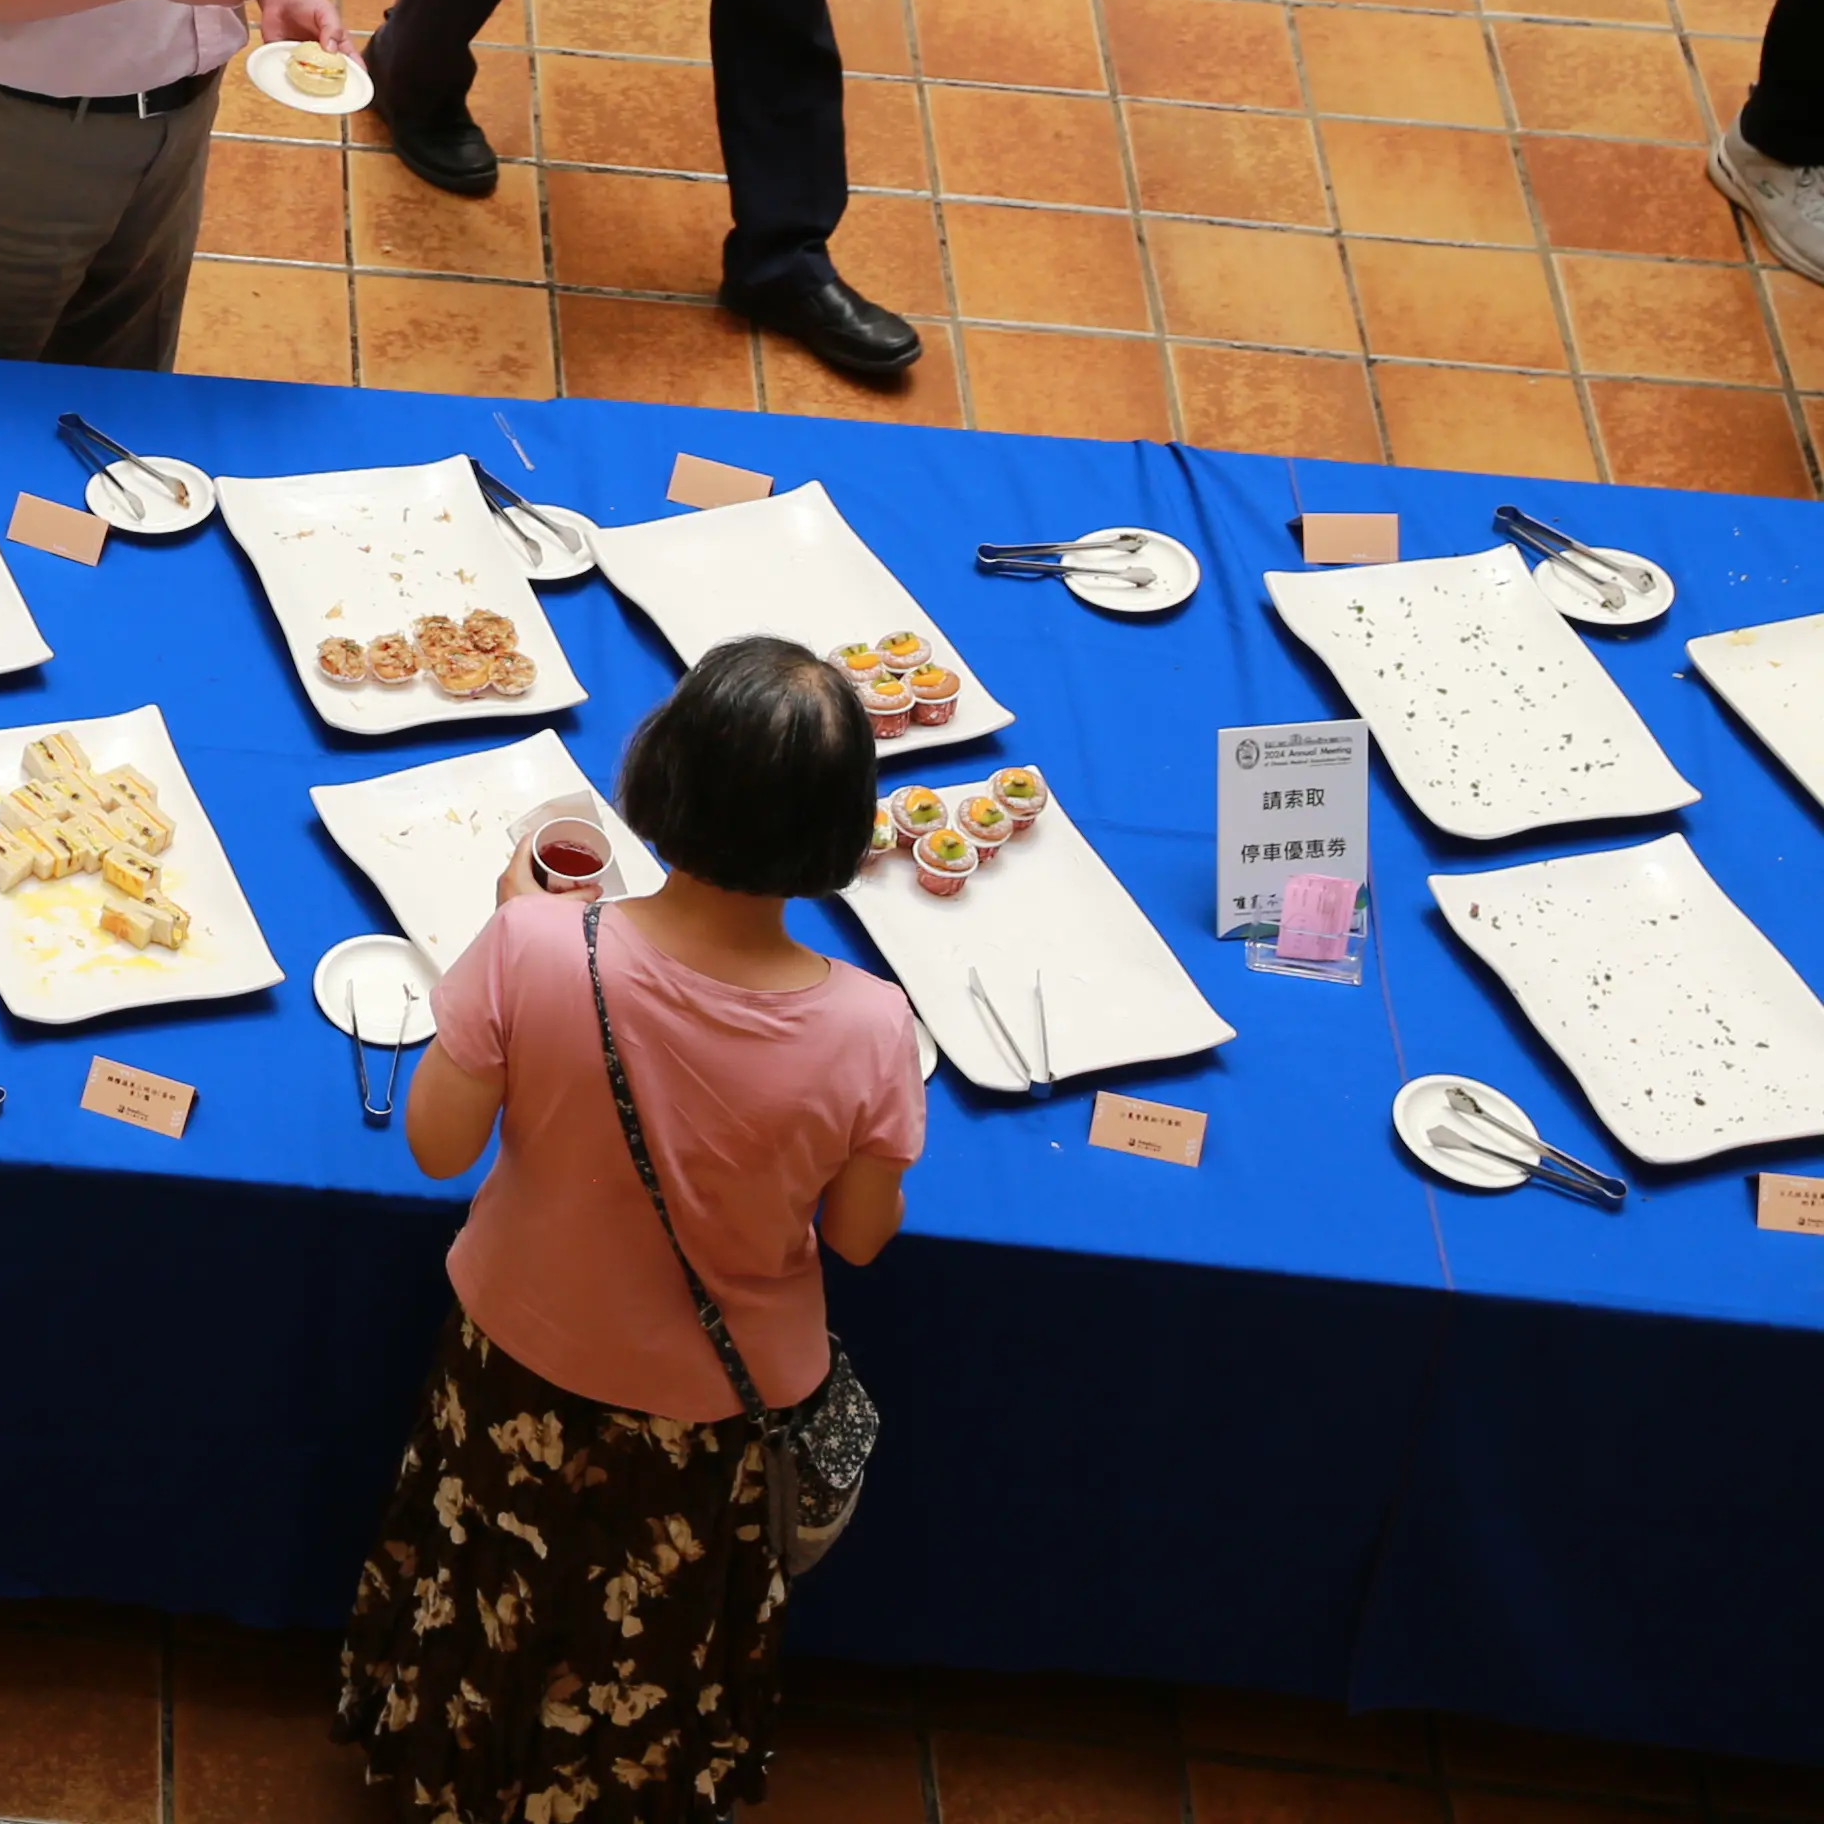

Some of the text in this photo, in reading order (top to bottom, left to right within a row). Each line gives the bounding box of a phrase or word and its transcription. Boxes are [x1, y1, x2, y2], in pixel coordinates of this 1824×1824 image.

[1289, 747, 1317, 757] Annual
[1320, 746, 1352, 755] Meeting
[1263, 787, 1325, 811] 請索取
[1241, 837, 1347, 864] 停車優惠券
